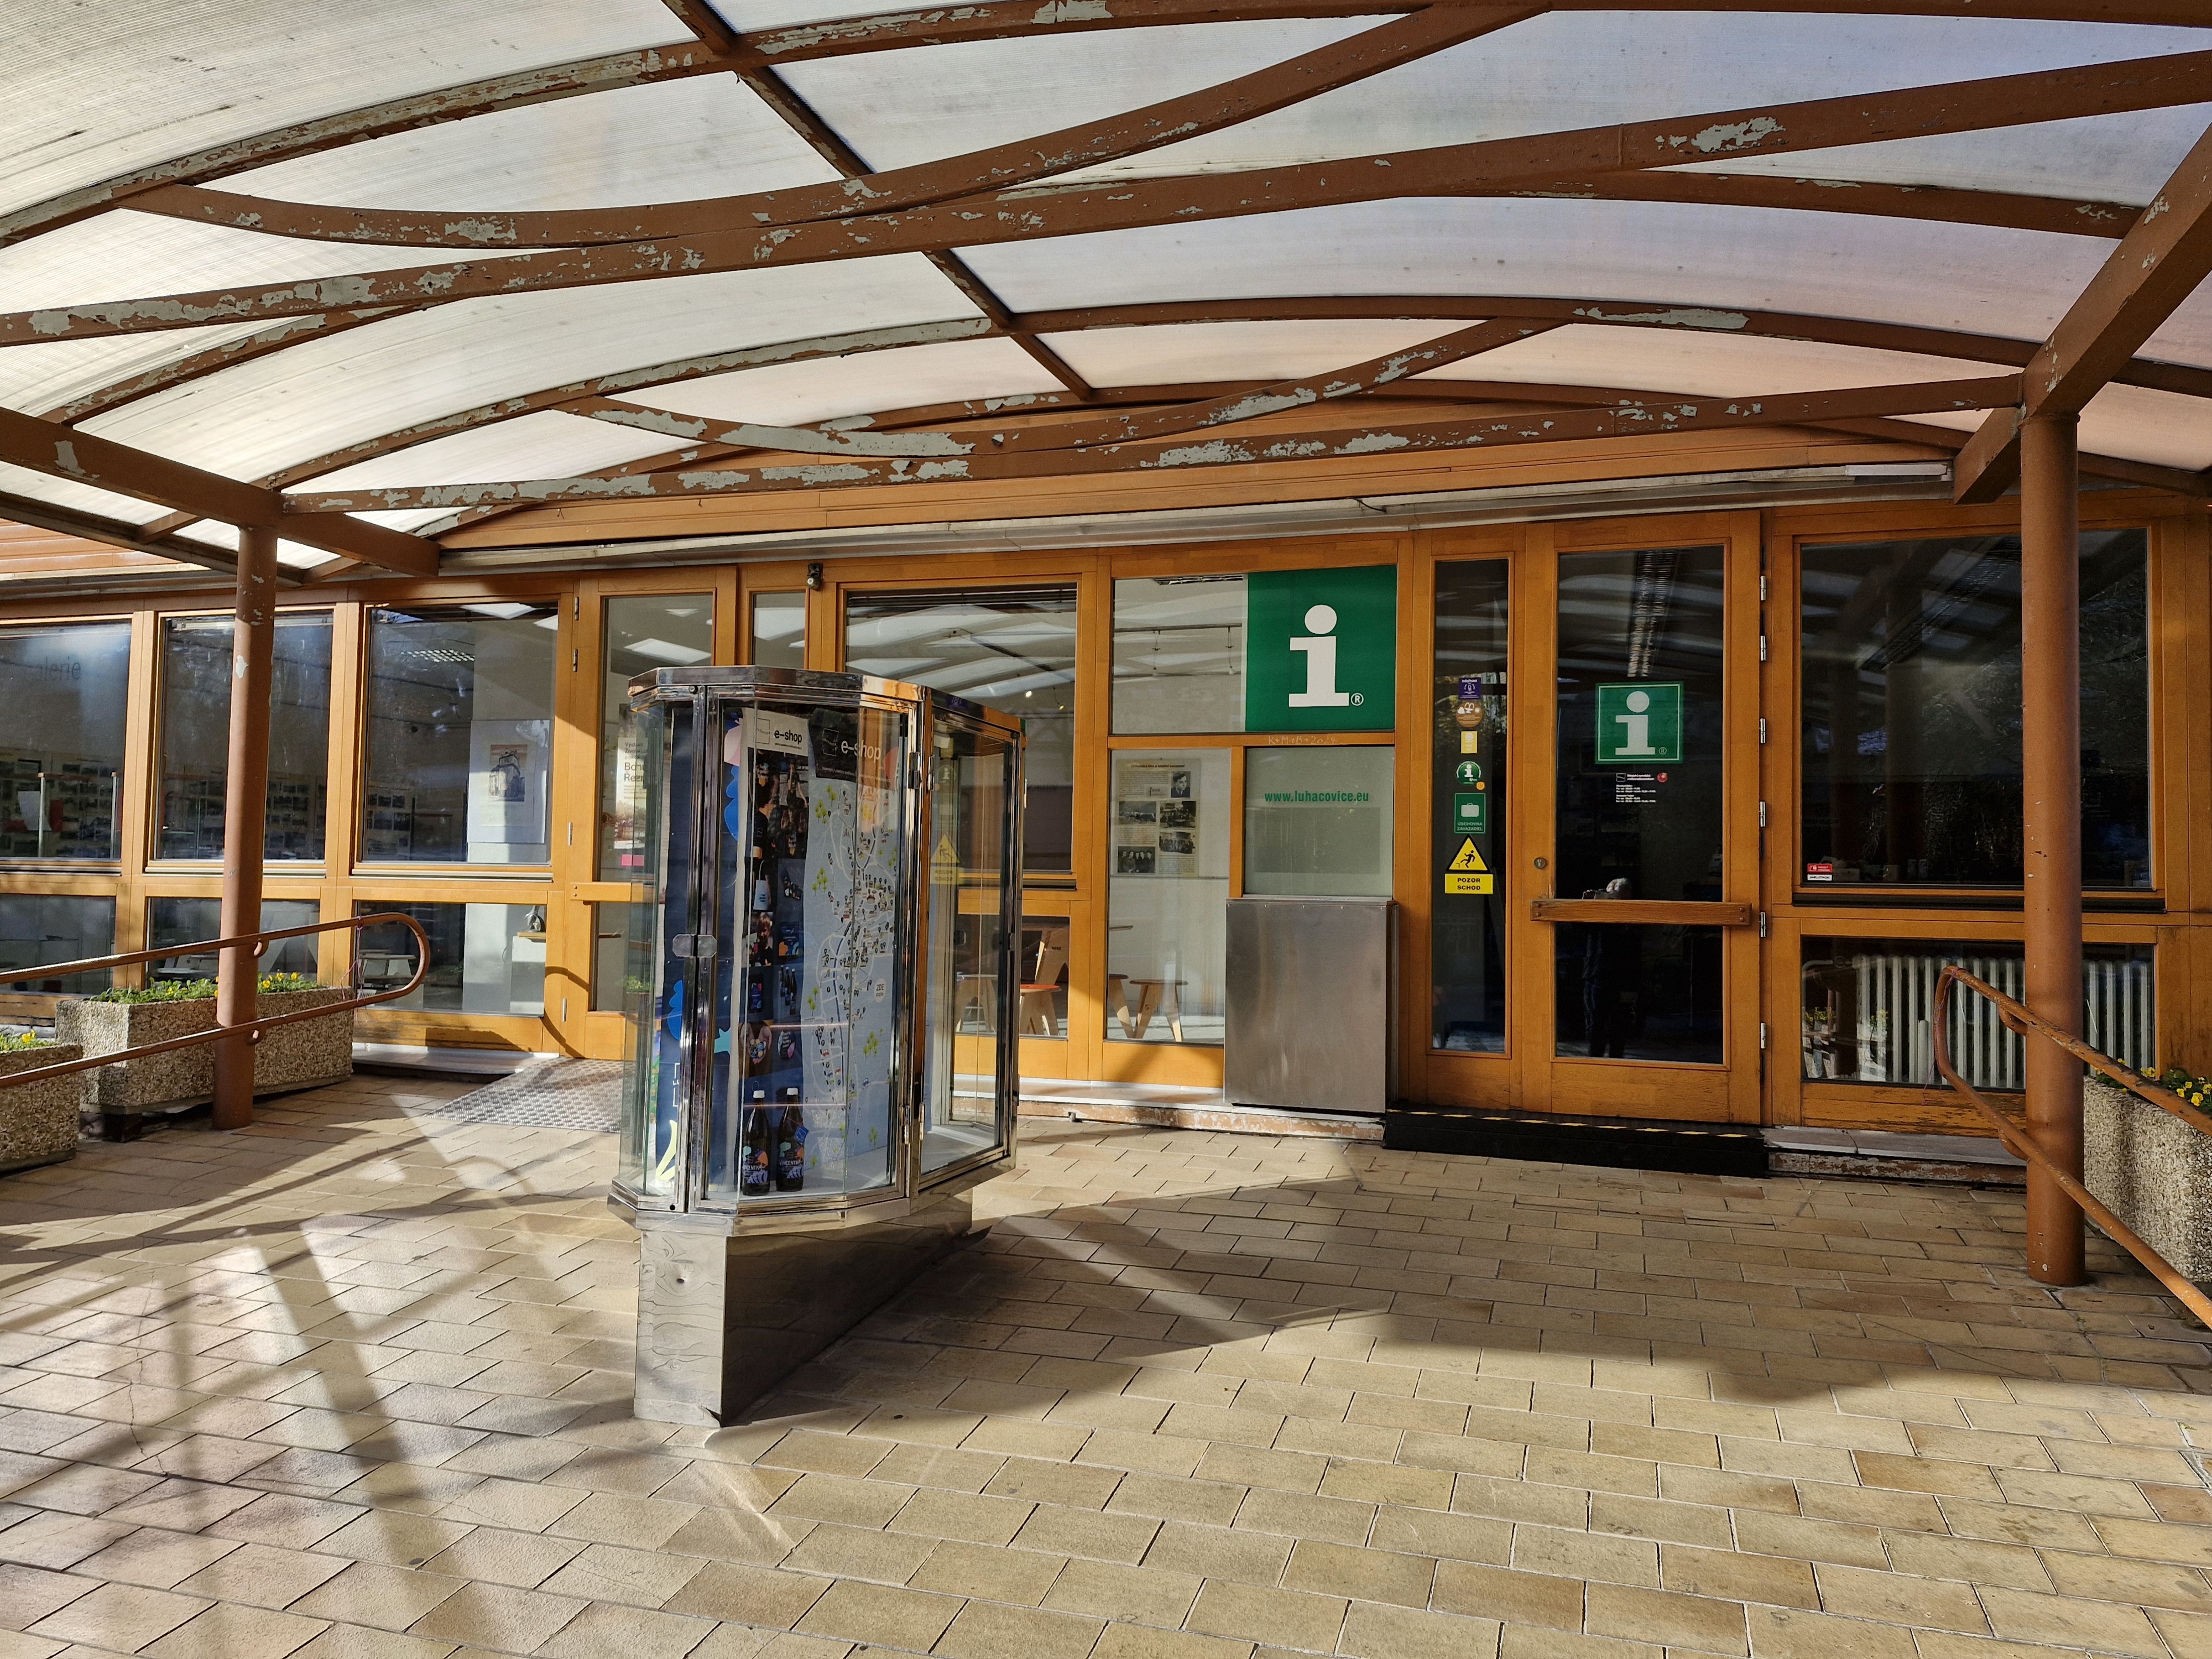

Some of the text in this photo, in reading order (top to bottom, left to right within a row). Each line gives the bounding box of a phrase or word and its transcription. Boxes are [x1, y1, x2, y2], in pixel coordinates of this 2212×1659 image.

[774, 729, 802, 745] e-shop
[841, 739, 881, 764] e-shop
[1264, 790, 1369, 802] www.luhacovice.eu
